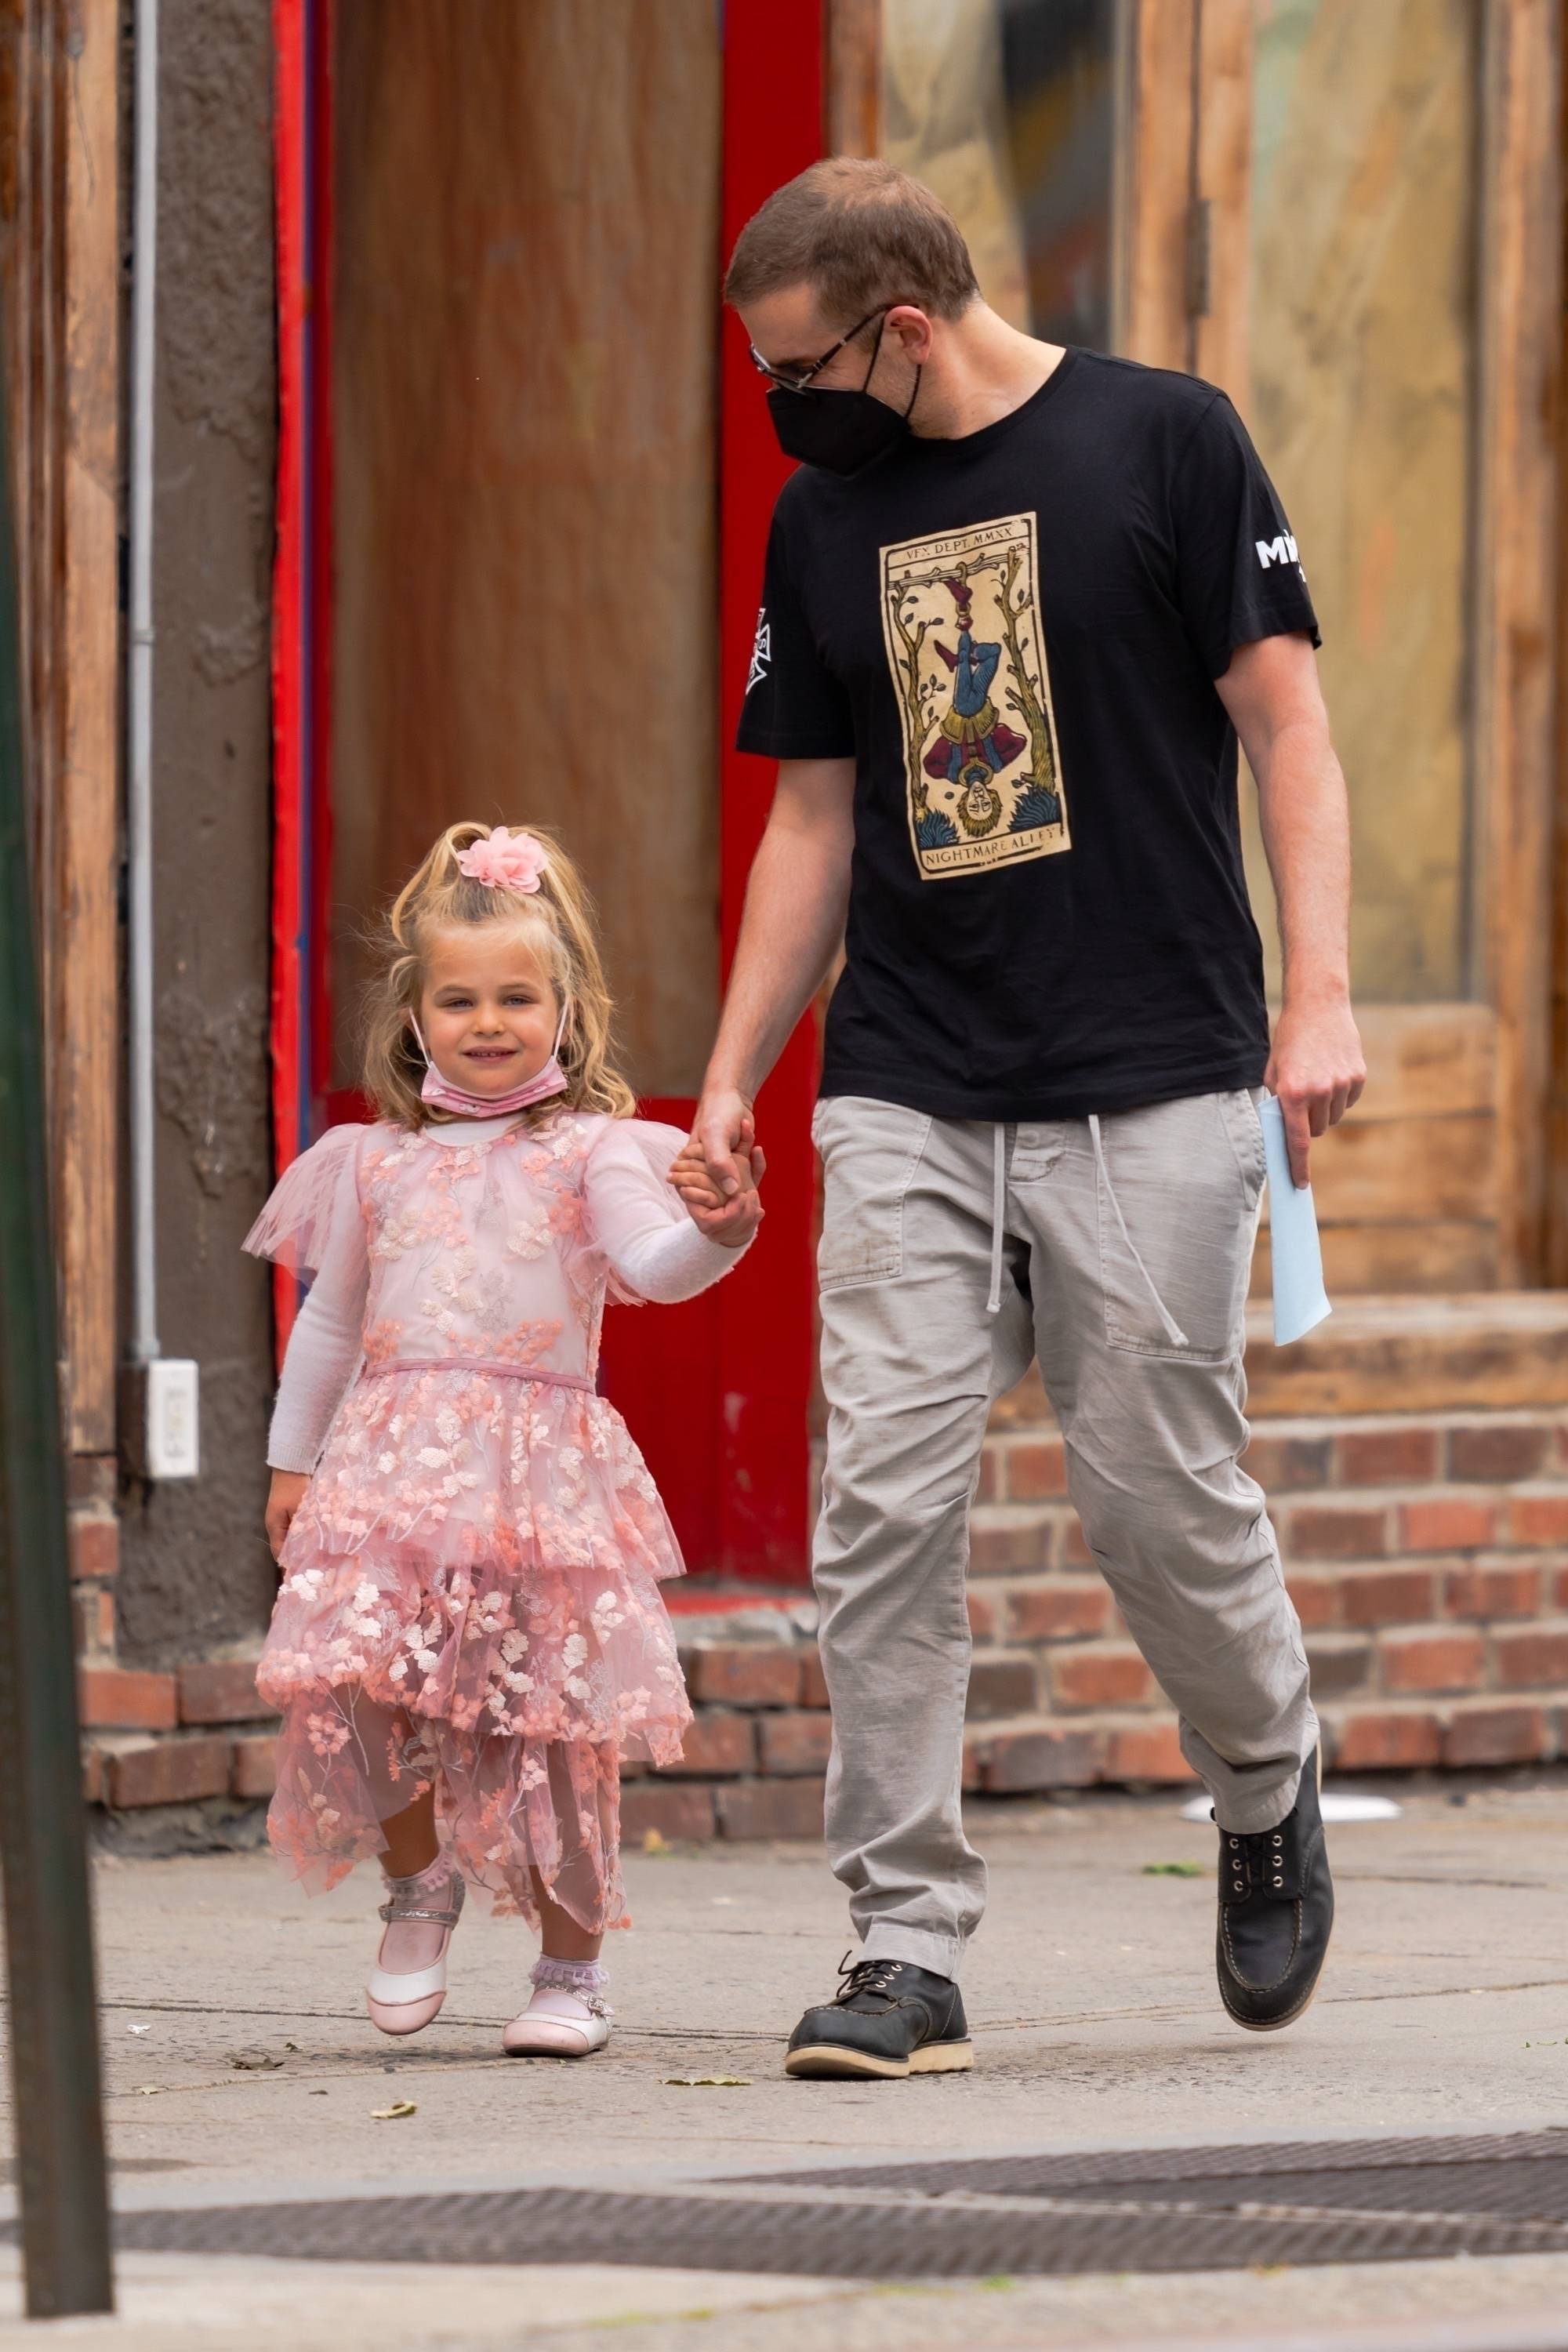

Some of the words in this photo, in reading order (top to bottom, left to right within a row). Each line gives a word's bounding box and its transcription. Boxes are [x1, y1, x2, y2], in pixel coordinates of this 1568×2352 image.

[906, 546, 931, 559] VFX
[935, 539, 970, 554] DEPT.
[974, 528, 1012, 545] MMXX
[926, 840, 1007, 866] NIGHTMARE
